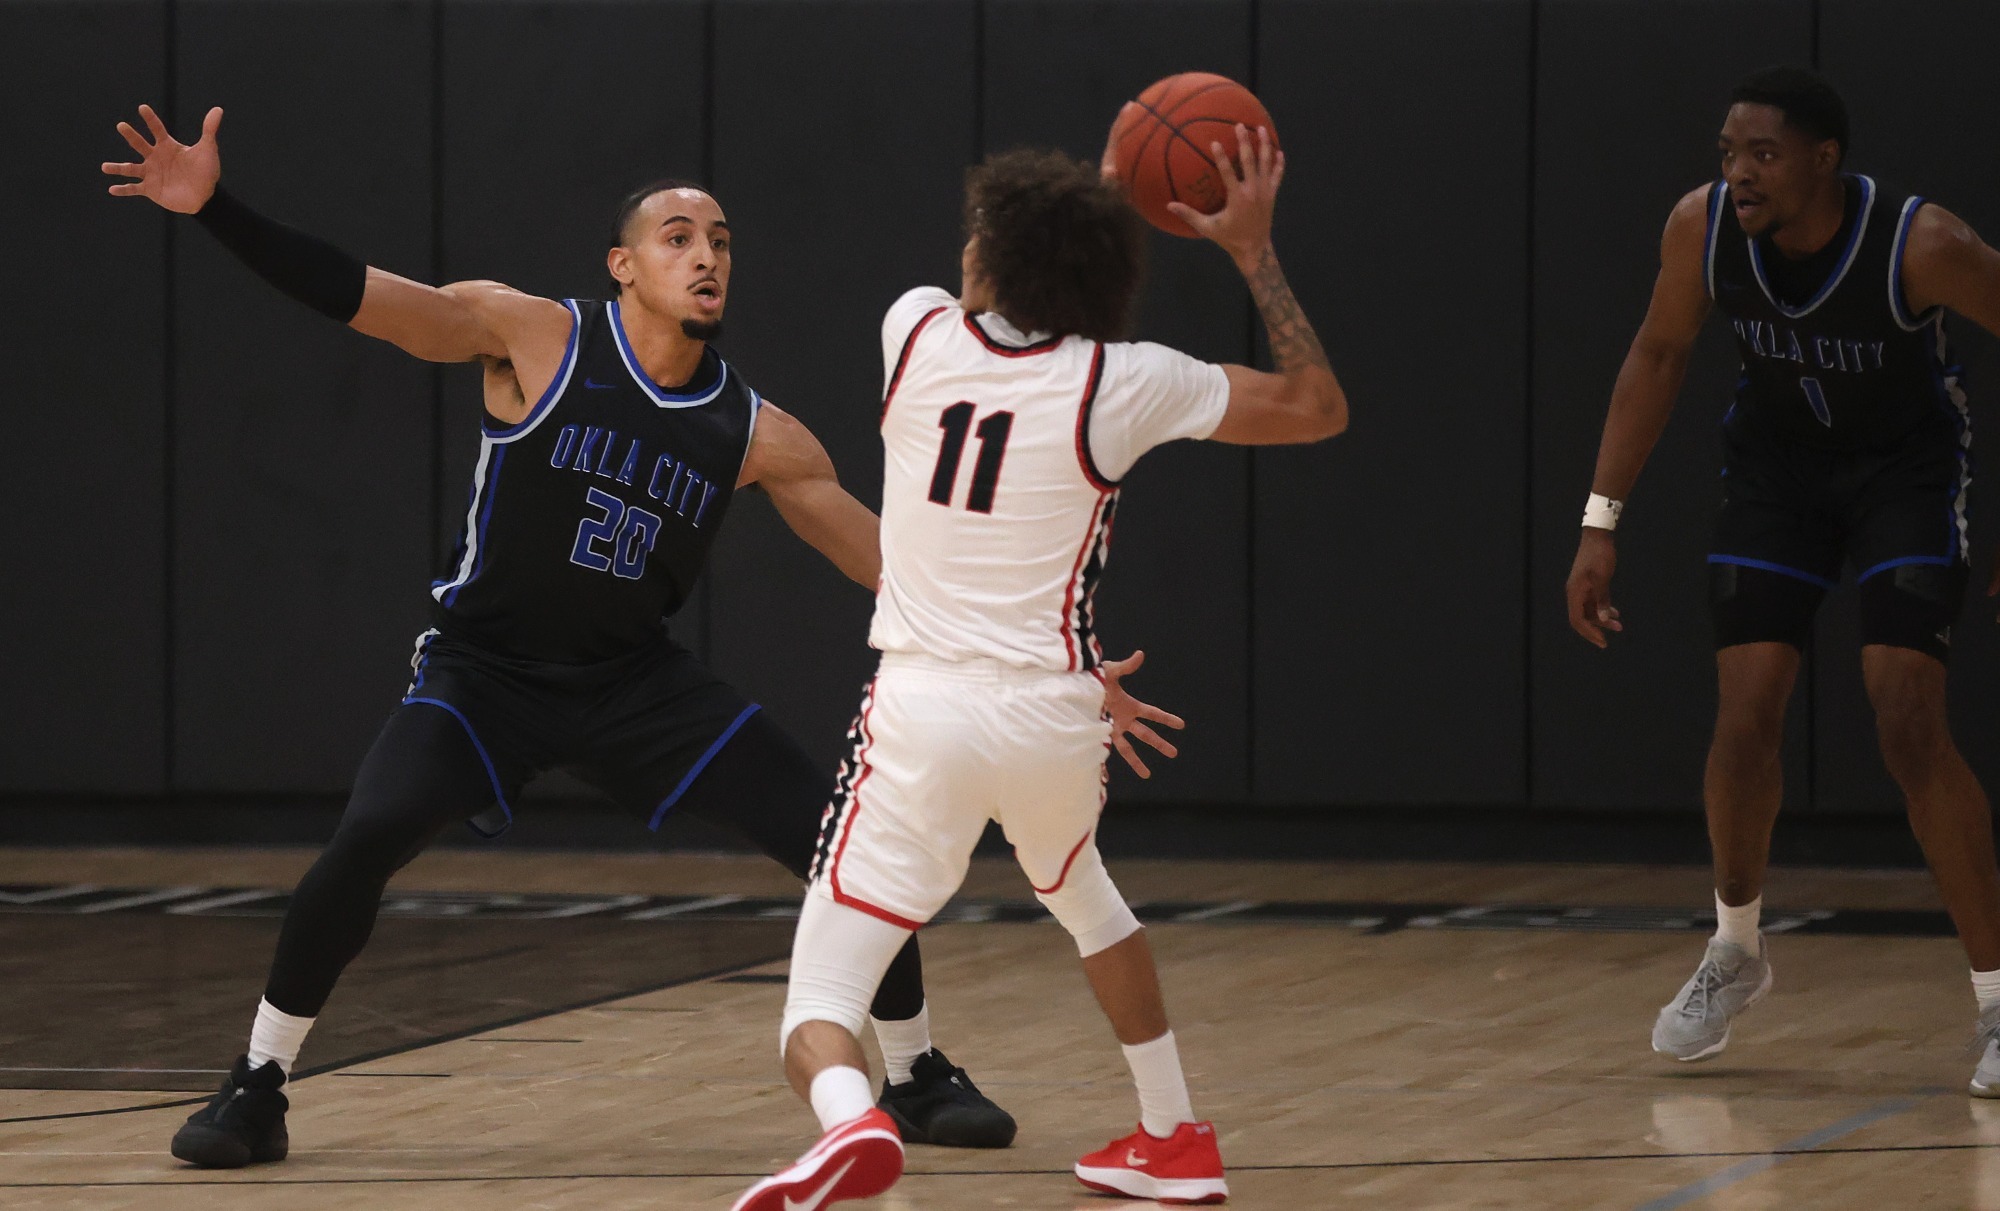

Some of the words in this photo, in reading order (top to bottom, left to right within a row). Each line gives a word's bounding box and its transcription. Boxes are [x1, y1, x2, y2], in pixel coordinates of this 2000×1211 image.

[1812, 336, 1884, 373] CITY
[1800, 376, 1831, 428] 1
[551, 423, 641, 487] OKLA
[648, 452, 718, 528] CITY
[928, 401, 1015, 514] 11
[569, 486, 662, 580] 20
